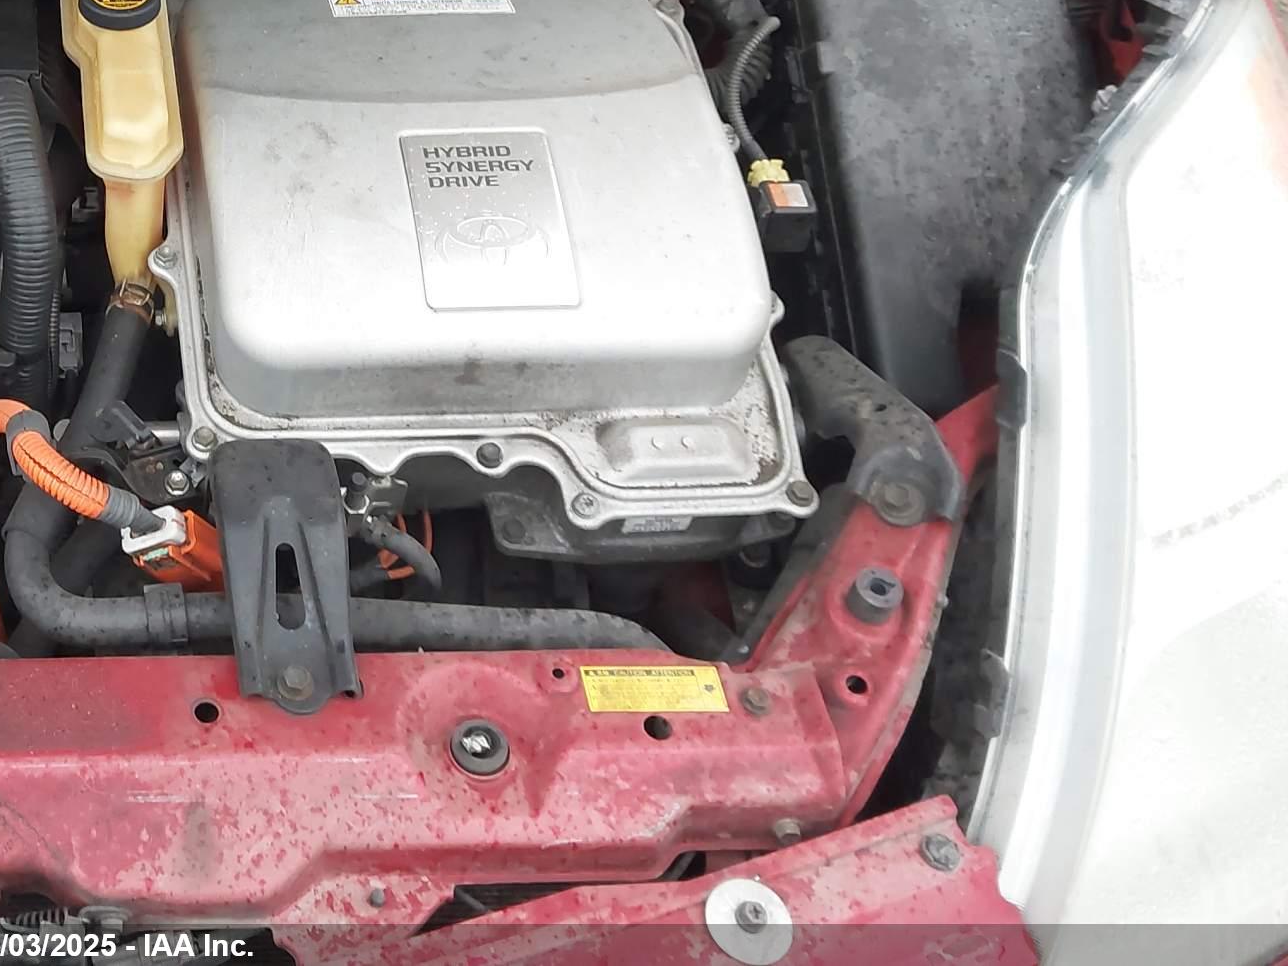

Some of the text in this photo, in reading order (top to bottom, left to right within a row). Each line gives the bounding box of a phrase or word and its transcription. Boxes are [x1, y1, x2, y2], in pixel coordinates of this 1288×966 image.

[423, 145, 511, 158] HYBRID
[425, 159, 534, 173] SYNERGY
[429, 175, 500, 188] DRIVE
